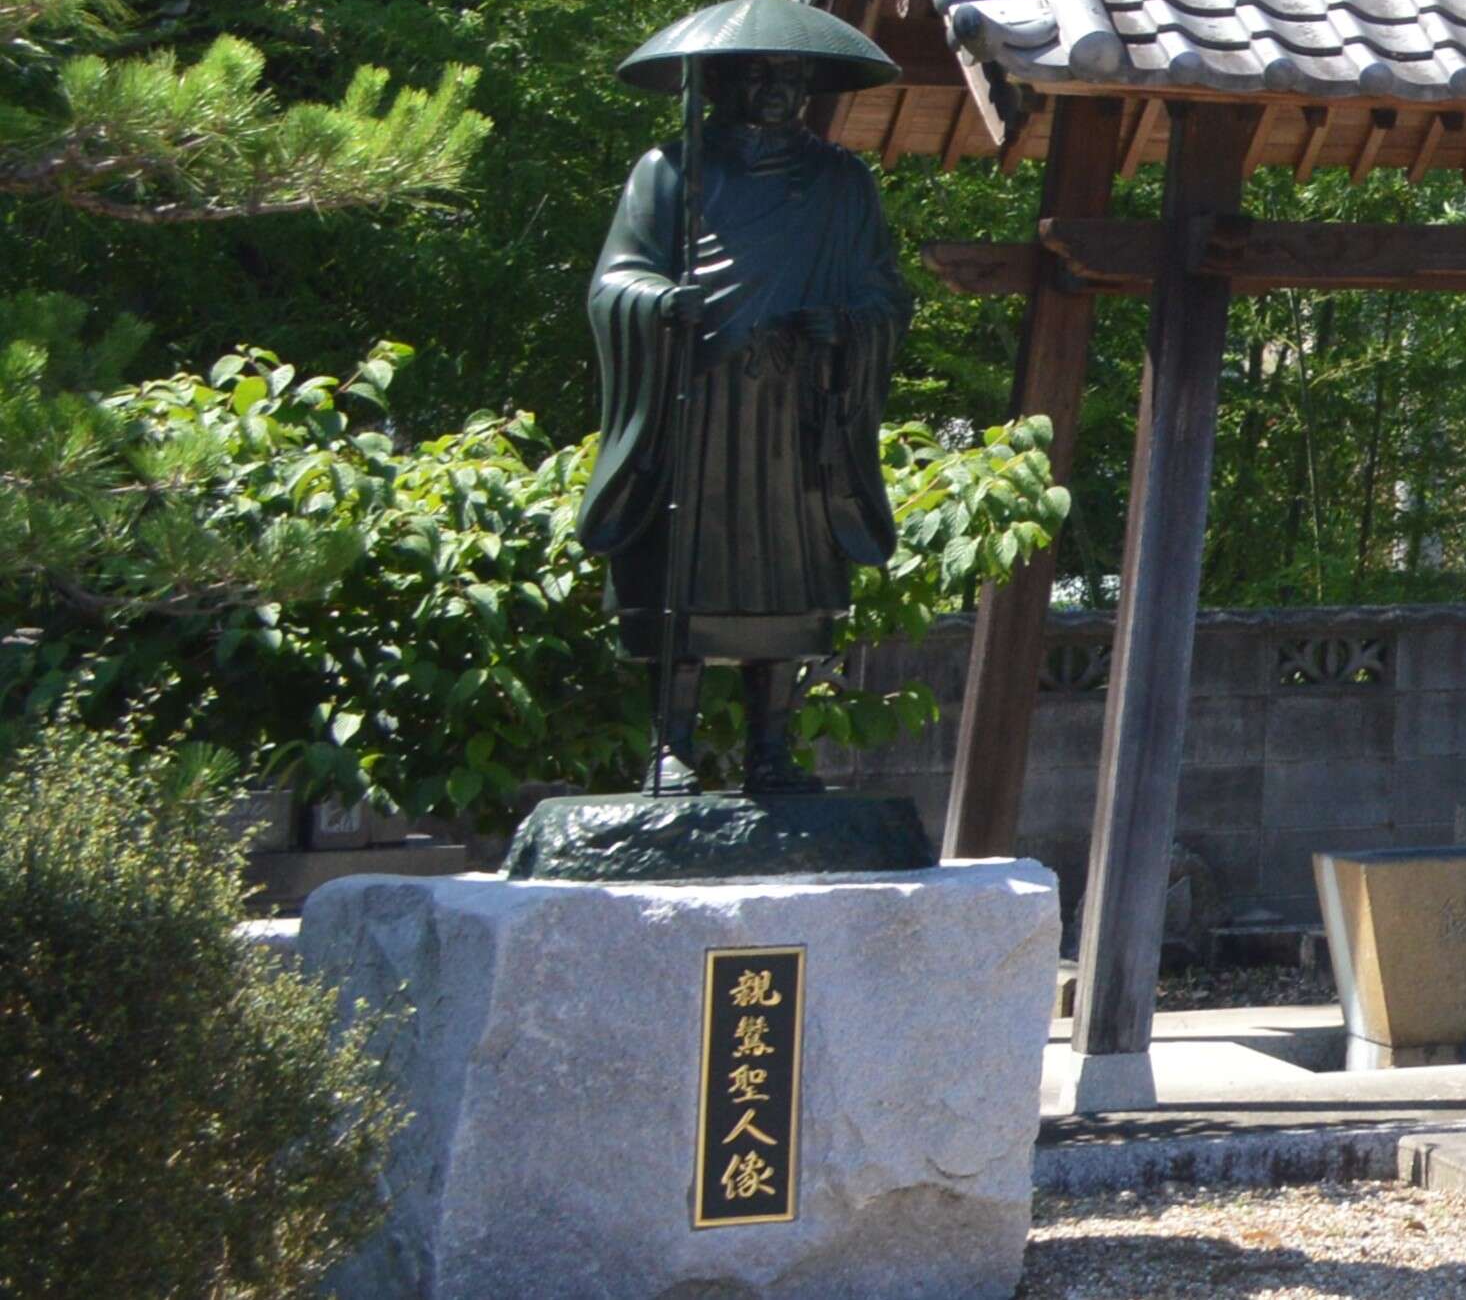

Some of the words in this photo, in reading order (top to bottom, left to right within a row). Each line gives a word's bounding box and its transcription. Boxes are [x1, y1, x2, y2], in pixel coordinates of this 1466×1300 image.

[721, 968, 782, 1200] 親鸞聖人像
